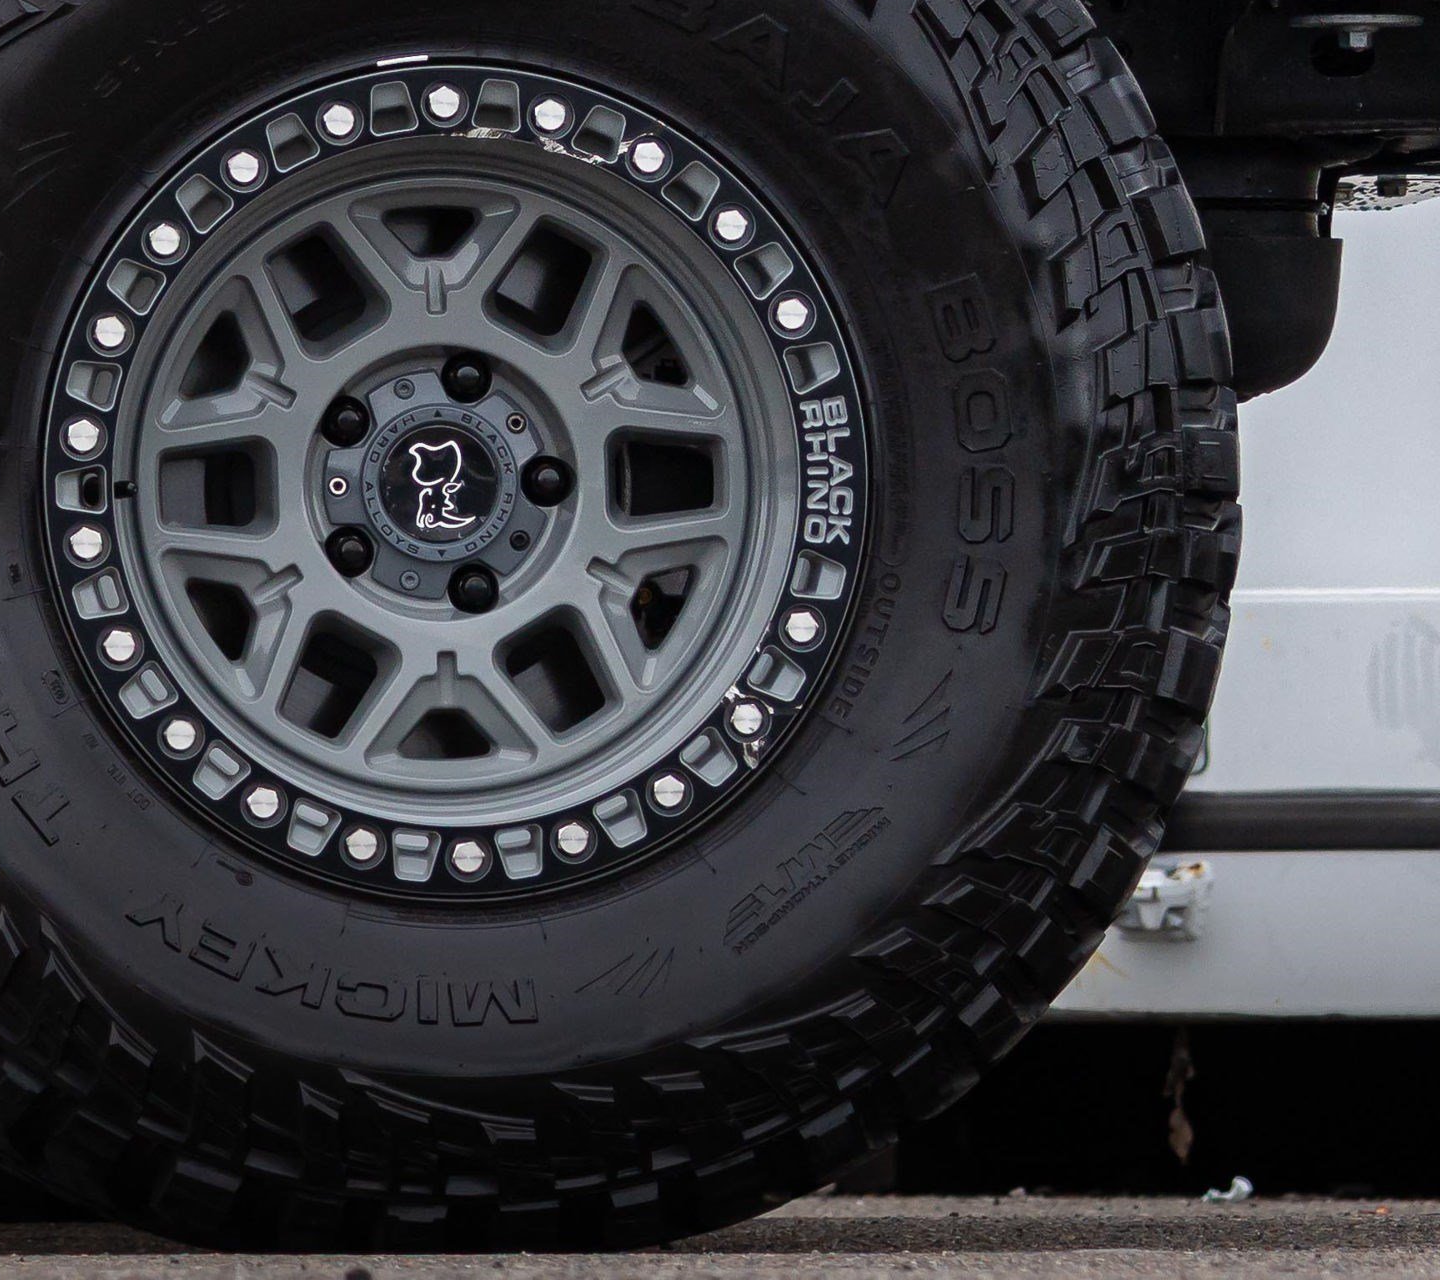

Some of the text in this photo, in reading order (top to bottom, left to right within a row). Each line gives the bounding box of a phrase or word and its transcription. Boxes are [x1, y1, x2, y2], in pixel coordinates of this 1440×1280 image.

[364, 414, 420, 555] HARD ALLOYS
[460, 413, 515, 553] BLACK RHINO
[799, 400, 829, 544] RHINO
[822, 395, 853, 545] BLACK
[924, 269, 1017, 635] BOSS
[833, 561, 905, 723] OUTSIDE
[125, 890, 539, 1026] MICKEY
